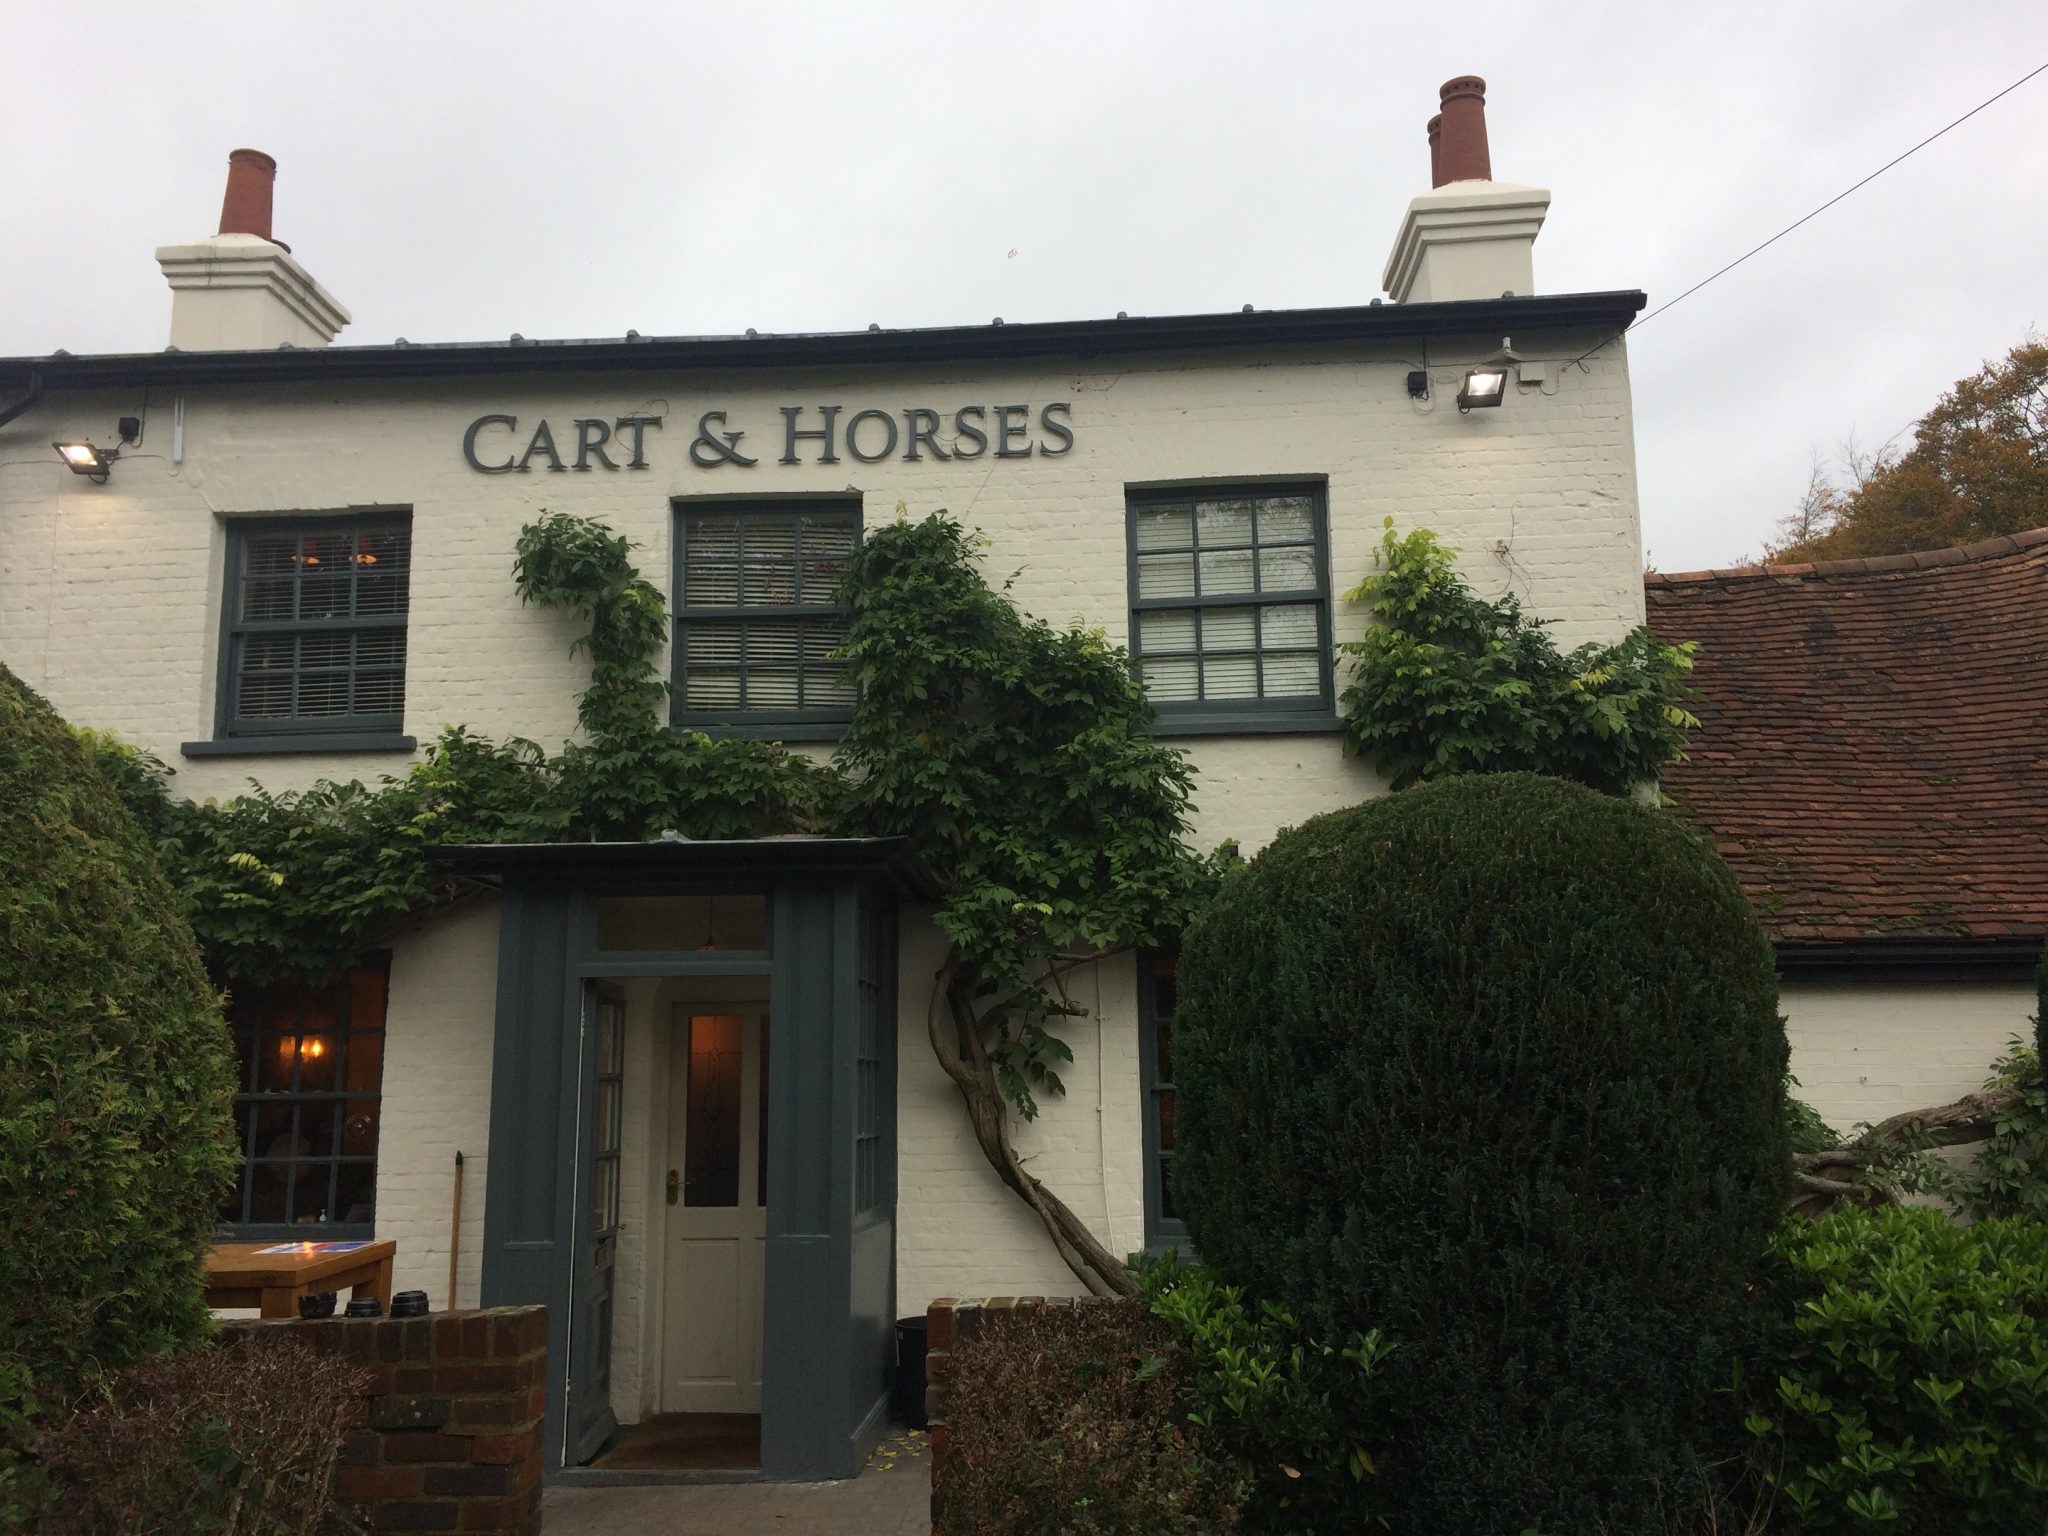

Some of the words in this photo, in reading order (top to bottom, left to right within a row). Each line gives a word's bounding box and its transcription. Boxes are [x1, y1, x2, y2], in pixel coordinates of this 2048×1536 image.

[462, 413, 663, 474] CART
[689, 410, 759, 468] &
[778, 402, 1075, 464] HORSES
